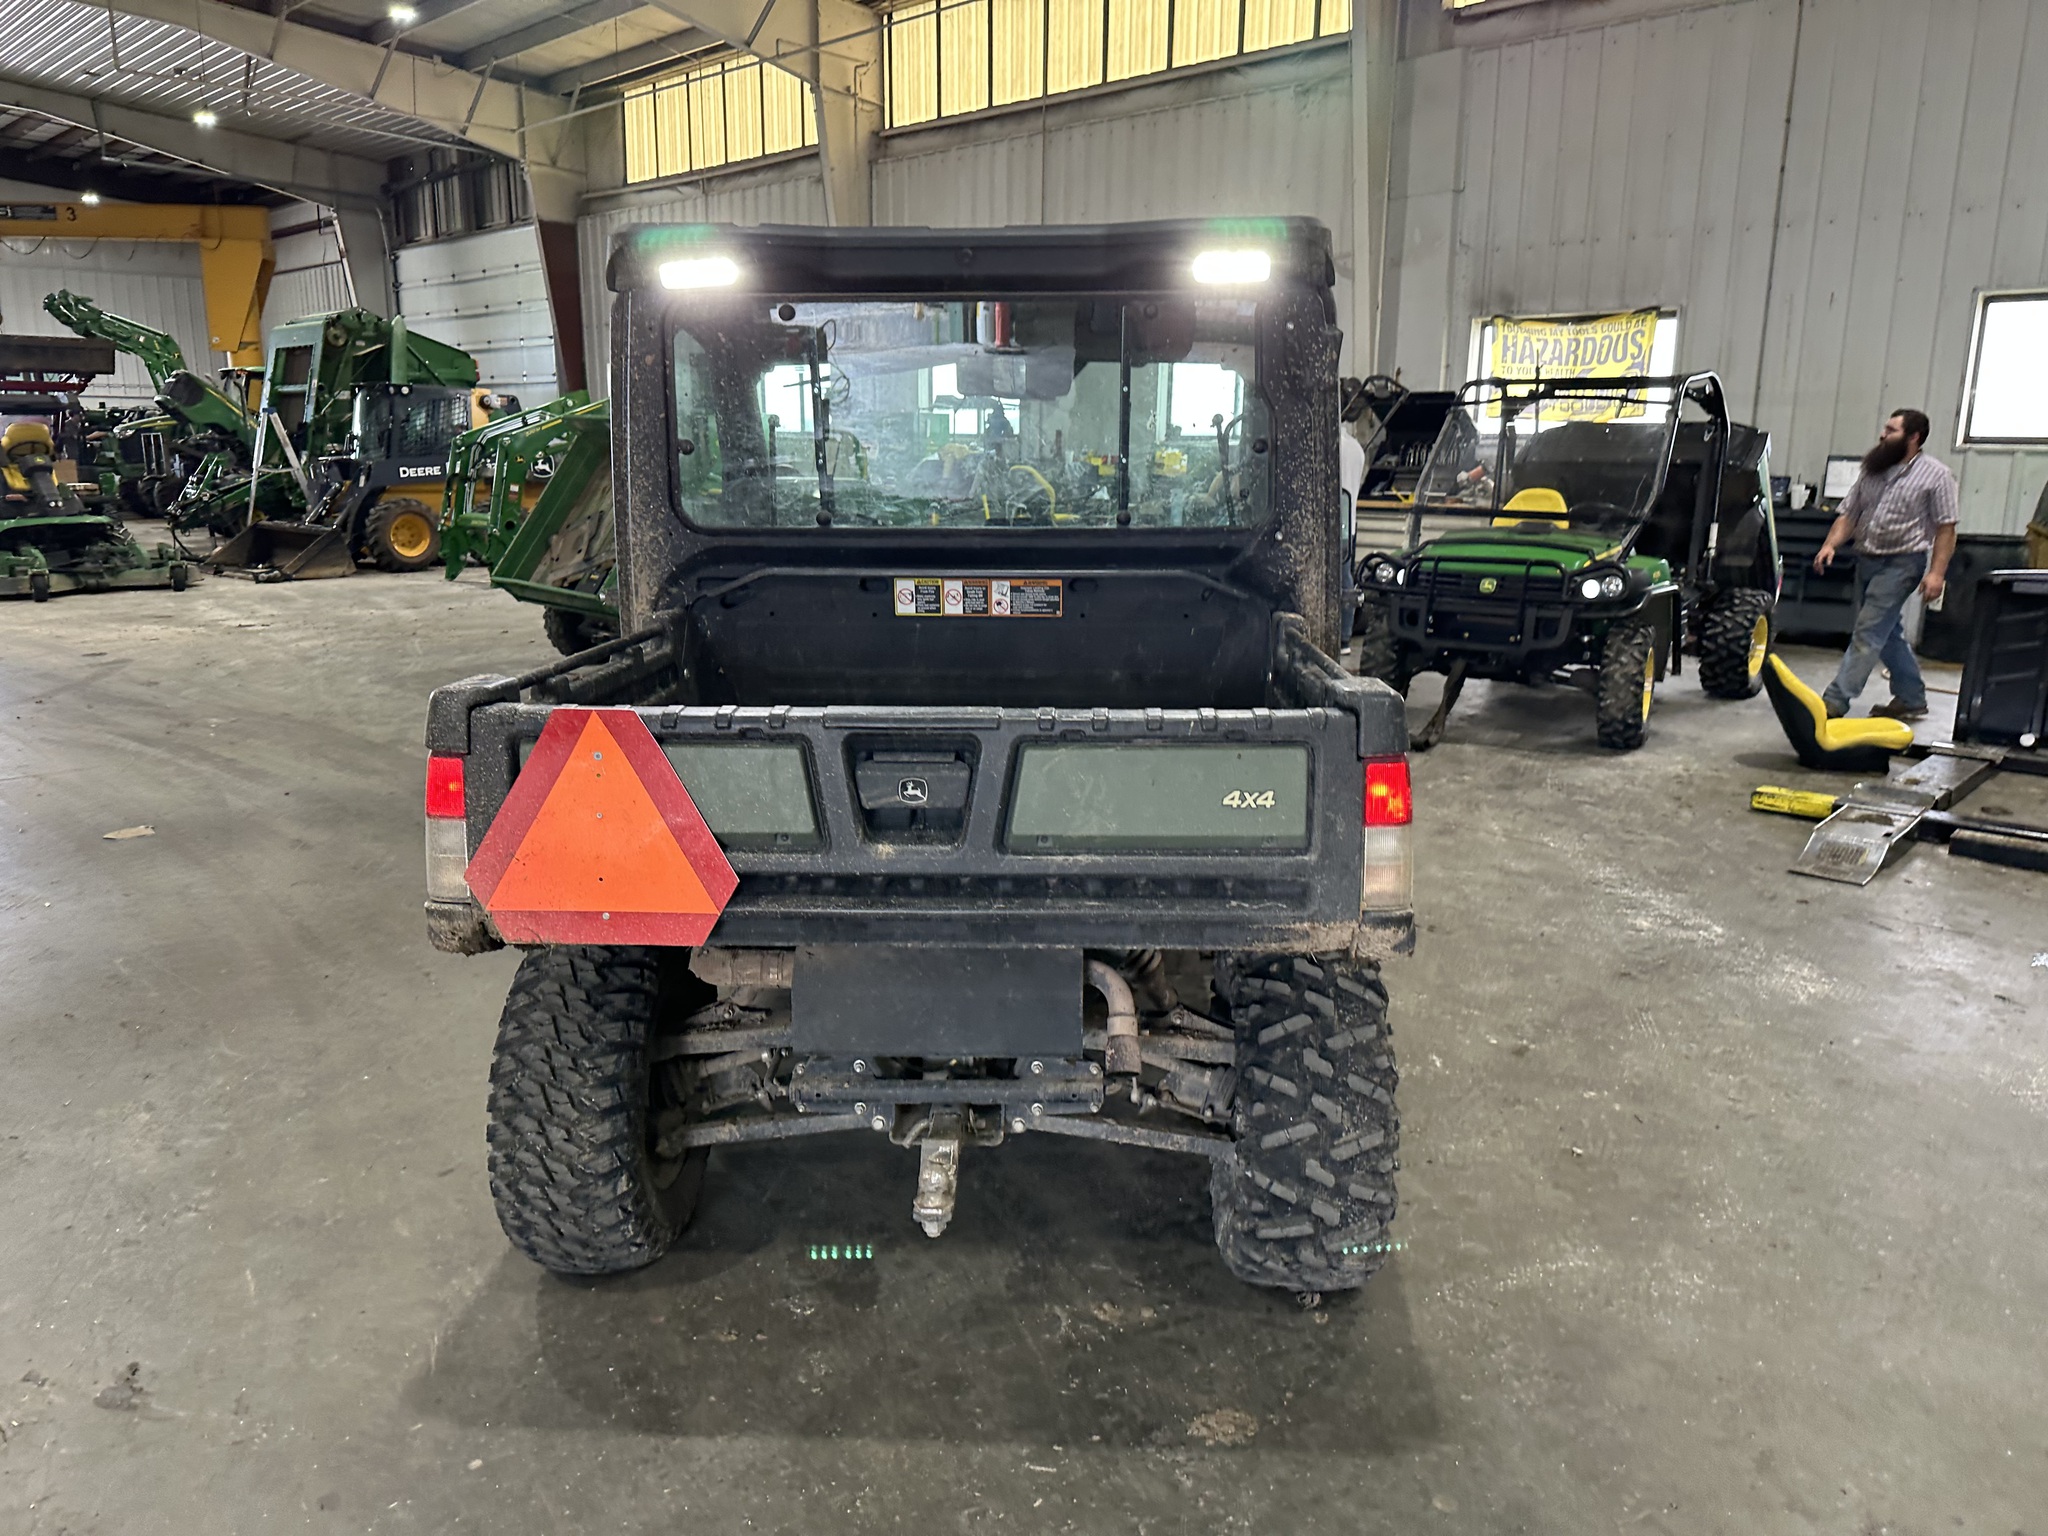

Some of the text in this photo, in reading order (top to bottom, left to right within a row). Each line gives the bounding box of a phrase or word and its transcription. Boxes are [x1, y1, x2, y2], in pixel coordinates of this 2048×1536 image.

[66, 207, 77, 221] 3
[1501, 318, 1647, 337] TOUCHING MY TOOLS COULD BE
[1501, 329, 1646, 367] HAZARDOUS
[1502, 365, 1513, 375] TO
[1545, 367, 1576, 378] HEALTH
[399, 466, 441, 478] DEERE
